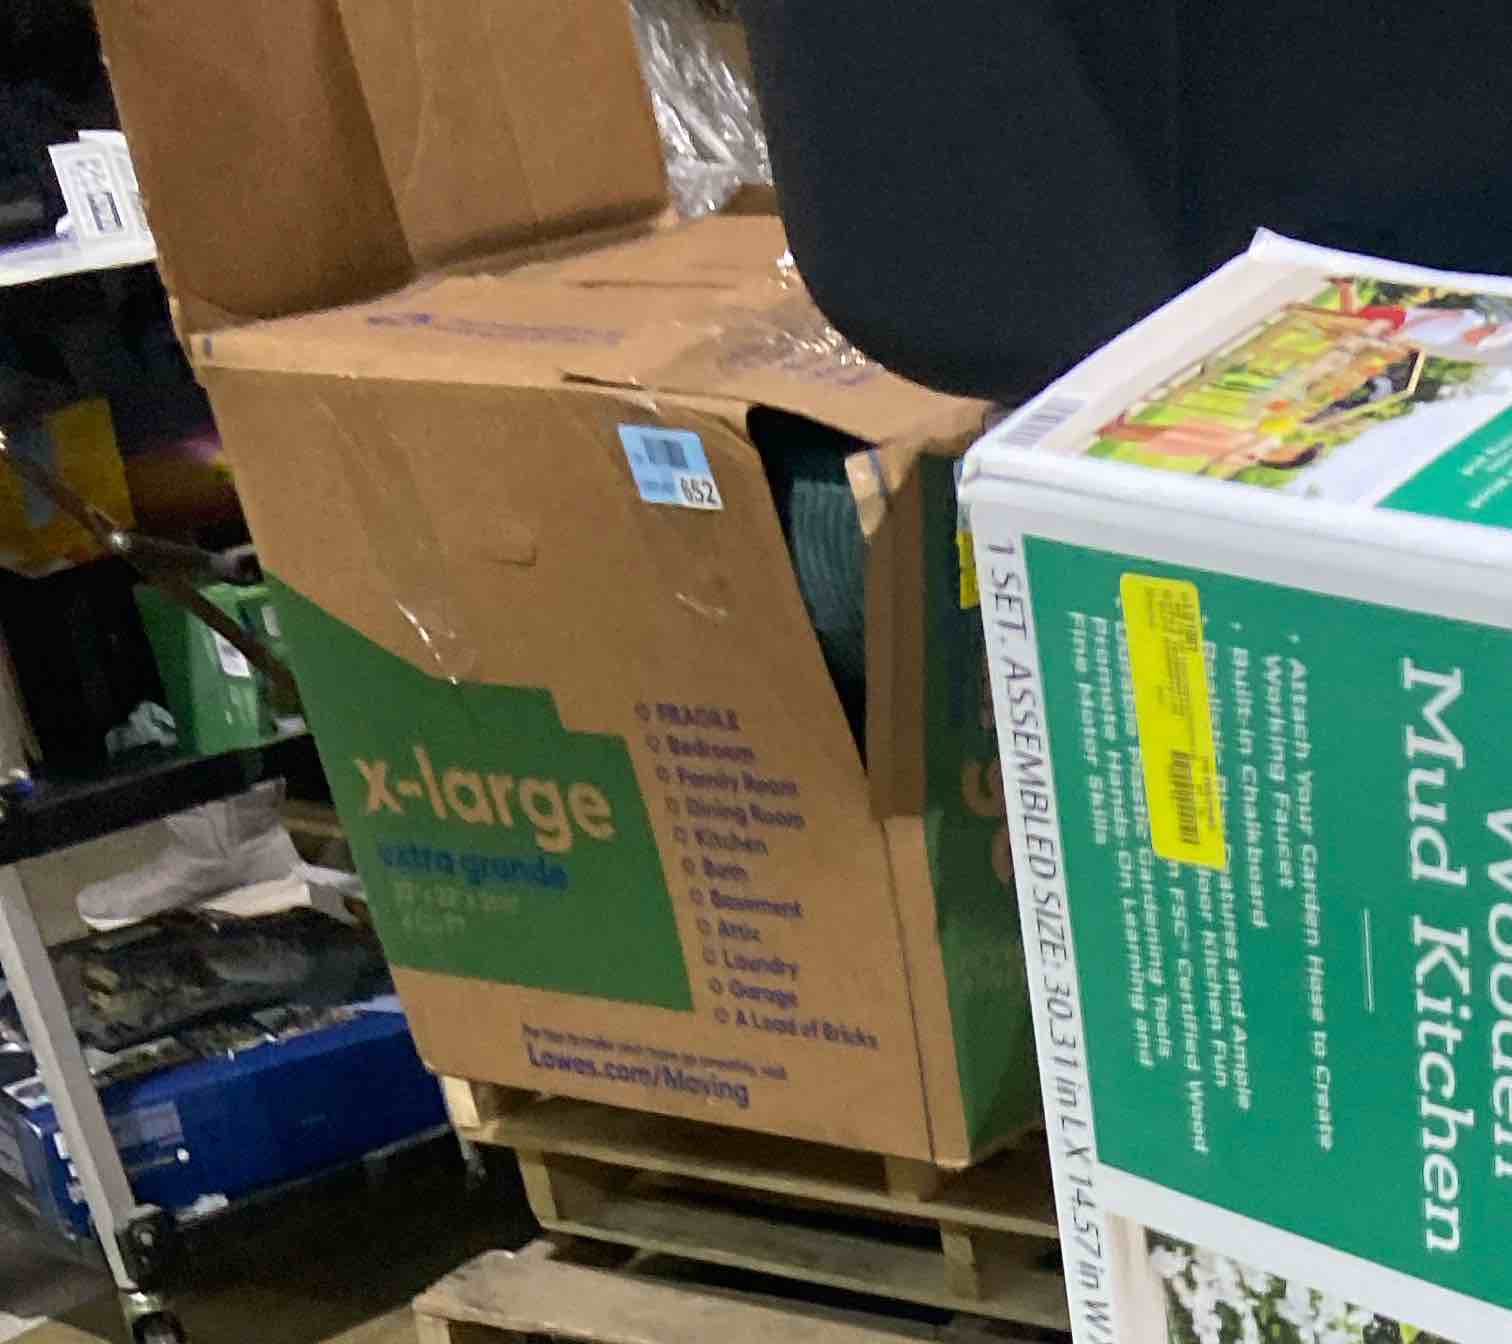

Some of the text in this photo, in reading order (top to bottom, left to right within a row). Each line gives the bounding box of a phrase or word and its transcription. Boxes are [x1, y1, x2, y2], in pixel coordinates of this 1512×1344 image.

[992, 568, 1027, 642] SET.
[1002, 656, 1056, 880] ASSEMBLED
[1067, 611, 1107, 845] Fine Motor Skills
[353, 744, 615, 852] x-large
[1231, 647, 1268, 927] Built-in Chalkboard
[1262, 655, 1294, 888] Working Faucet
[1090, 617, 1153, 1068] Promote Hands-On Learning and
[1033, 888, 1066, 968] SIZE:
[1289, 658, 1333, 1150] Attach Your Garden Hose to Create
[723, 949, 799, 980] Laundry
[1139, 848, 1164, 985] Gardening
[1154, 994, 1171, 1059] Tools
[1201, 931, 1224, 1031] Kitchen
[1227, 968, 1246, 1018] and
[1402, 657, 1474, 1253] Mud Kitchen
[1044, 976, 1078, 1067] 30.31
[1176, 959, 1200, 1071] Certified
[527, 1042, 749, 1109] Lowes.com/Moving
[1056, 1078, 1083, 1107] in
[1212, 1040, 1228, 1088] Fun
[1230, 1025, 1252, 1110] Ample
[1061, 1116, 1087, 1132] L
[1186, 1081, 1209, 1153] Wood
[1070, 1176, 1101, 1257] 14.57
[1079, 1261, 1105, 1290] in
[1084, 1300, 1110, 1329] W
